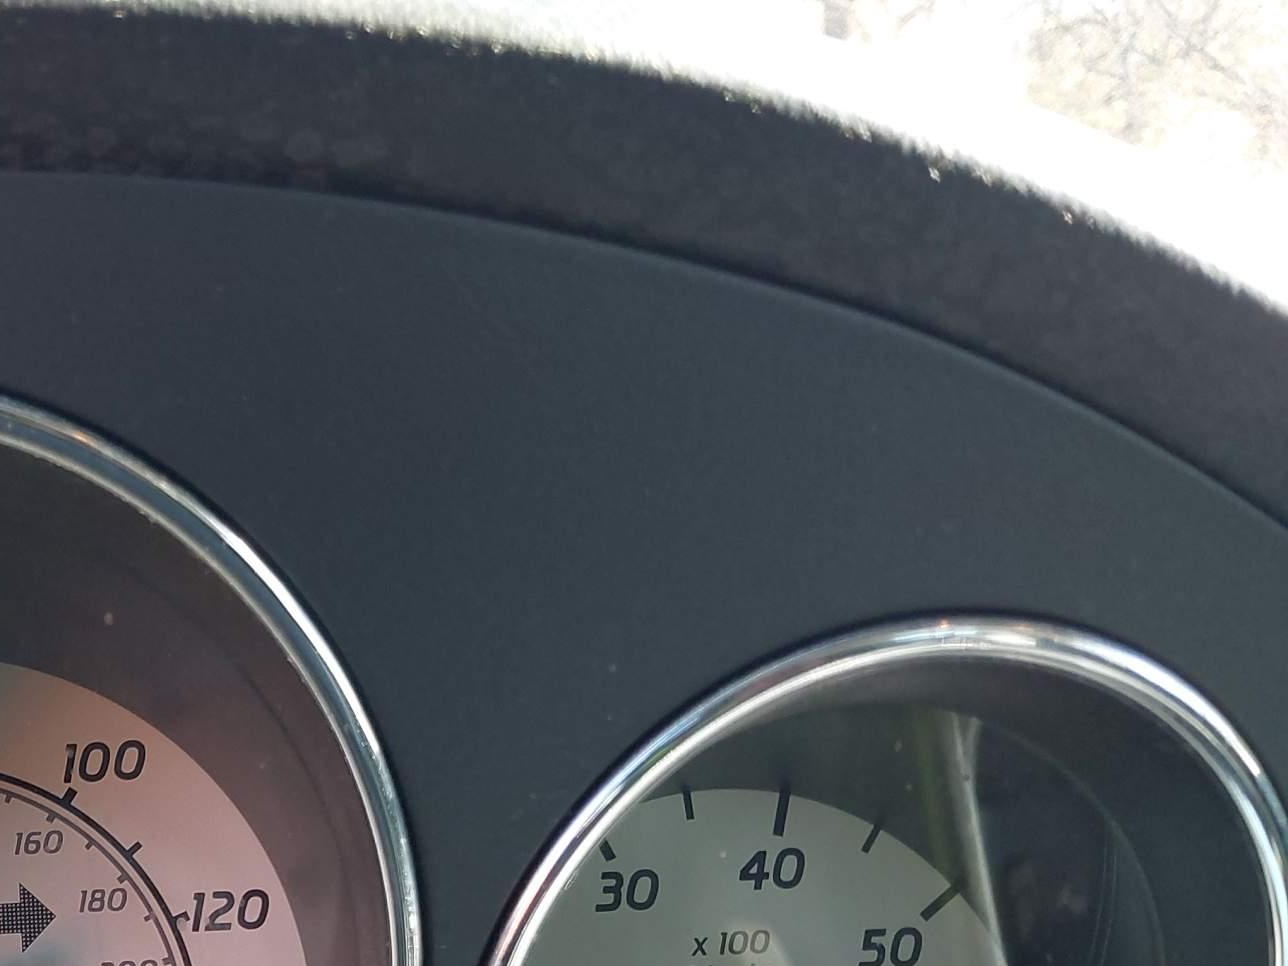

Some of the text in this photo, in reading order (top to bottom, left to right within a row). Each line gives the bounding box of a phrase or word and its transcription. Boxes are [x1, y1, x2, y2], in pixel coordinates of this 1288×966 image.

[64, 740, 147, 783] 100
[14, 829, 64, 856] 160
[739, 846, 806, 891] 40
[79, 887, 128, 913] 180
[191, 888, 270, 932] 120
[595, 868, 660, 913] 30
[692, 929, 772, 957] x 100
